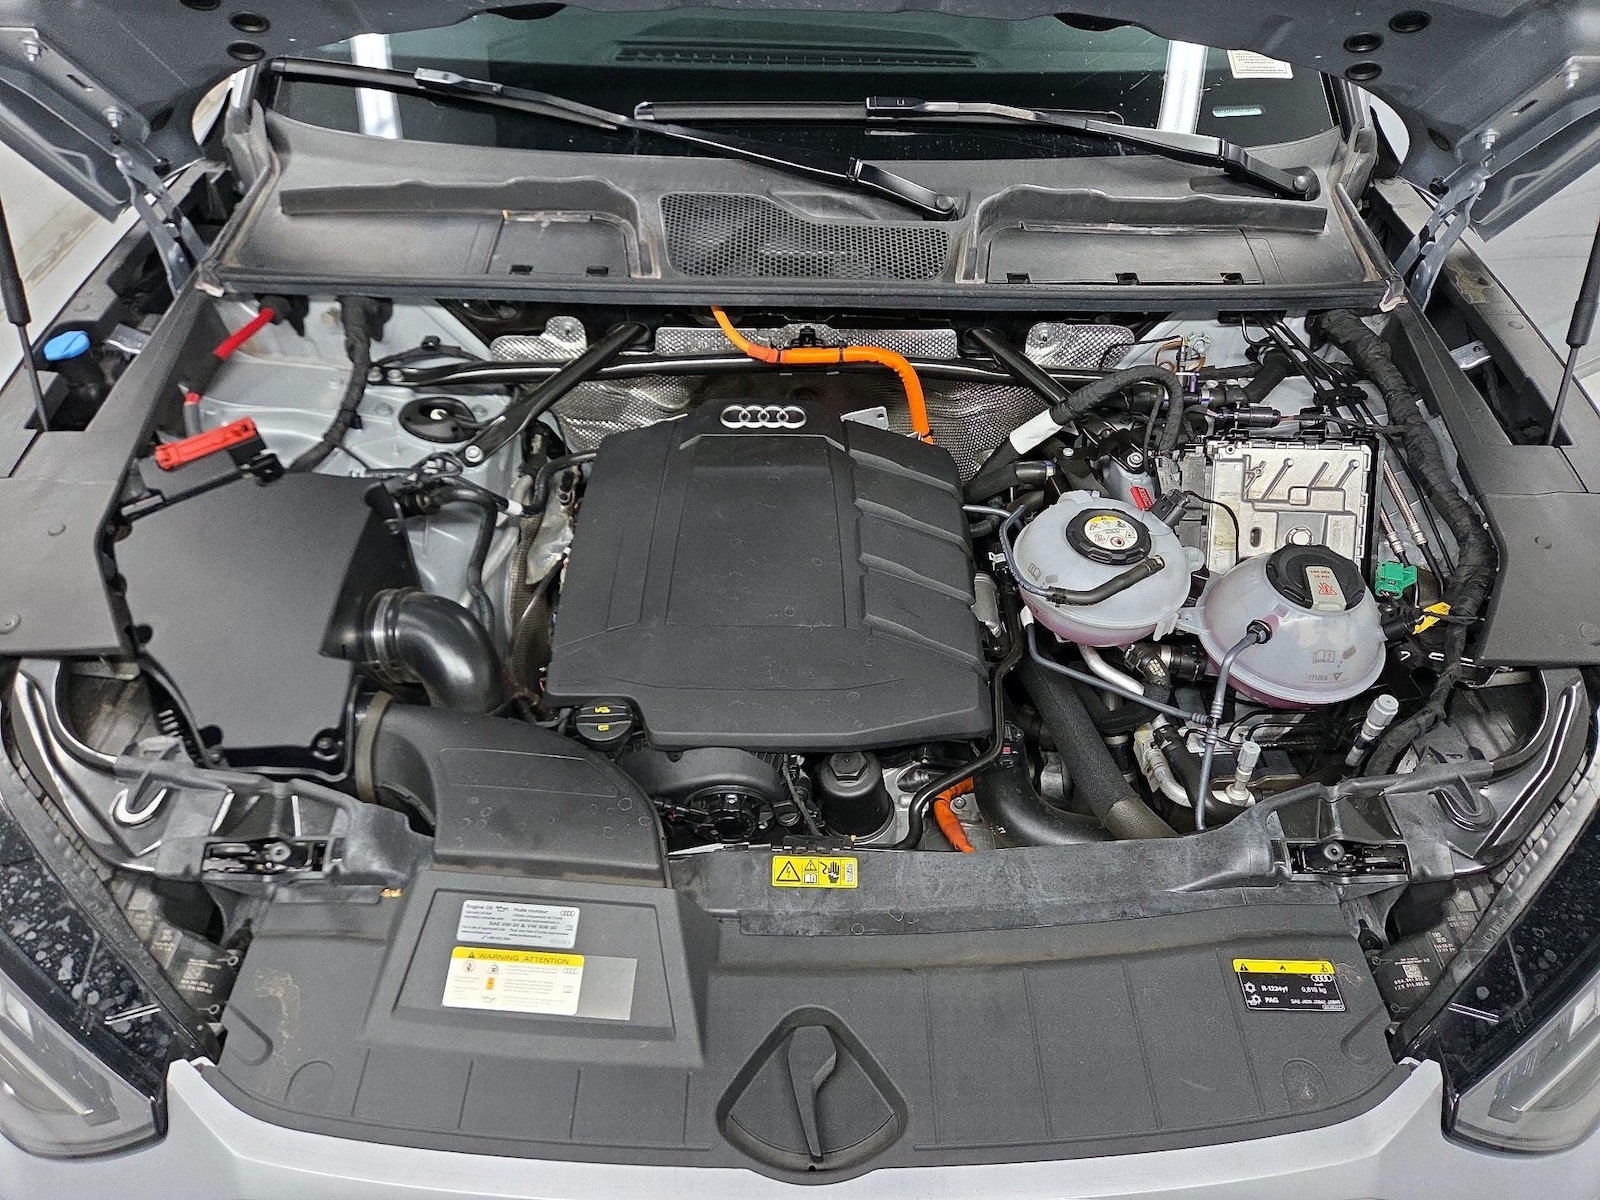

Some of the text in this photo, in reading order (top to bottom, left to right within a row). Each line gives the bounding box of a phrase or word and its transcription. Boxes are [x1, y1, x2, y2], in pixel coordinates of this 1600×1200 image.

[479, 953, 570, 965] WARNING ATTENTION
[1261, 985, 1288, 993] R-1234yf
[1319, 986, 1327, 994] kg
